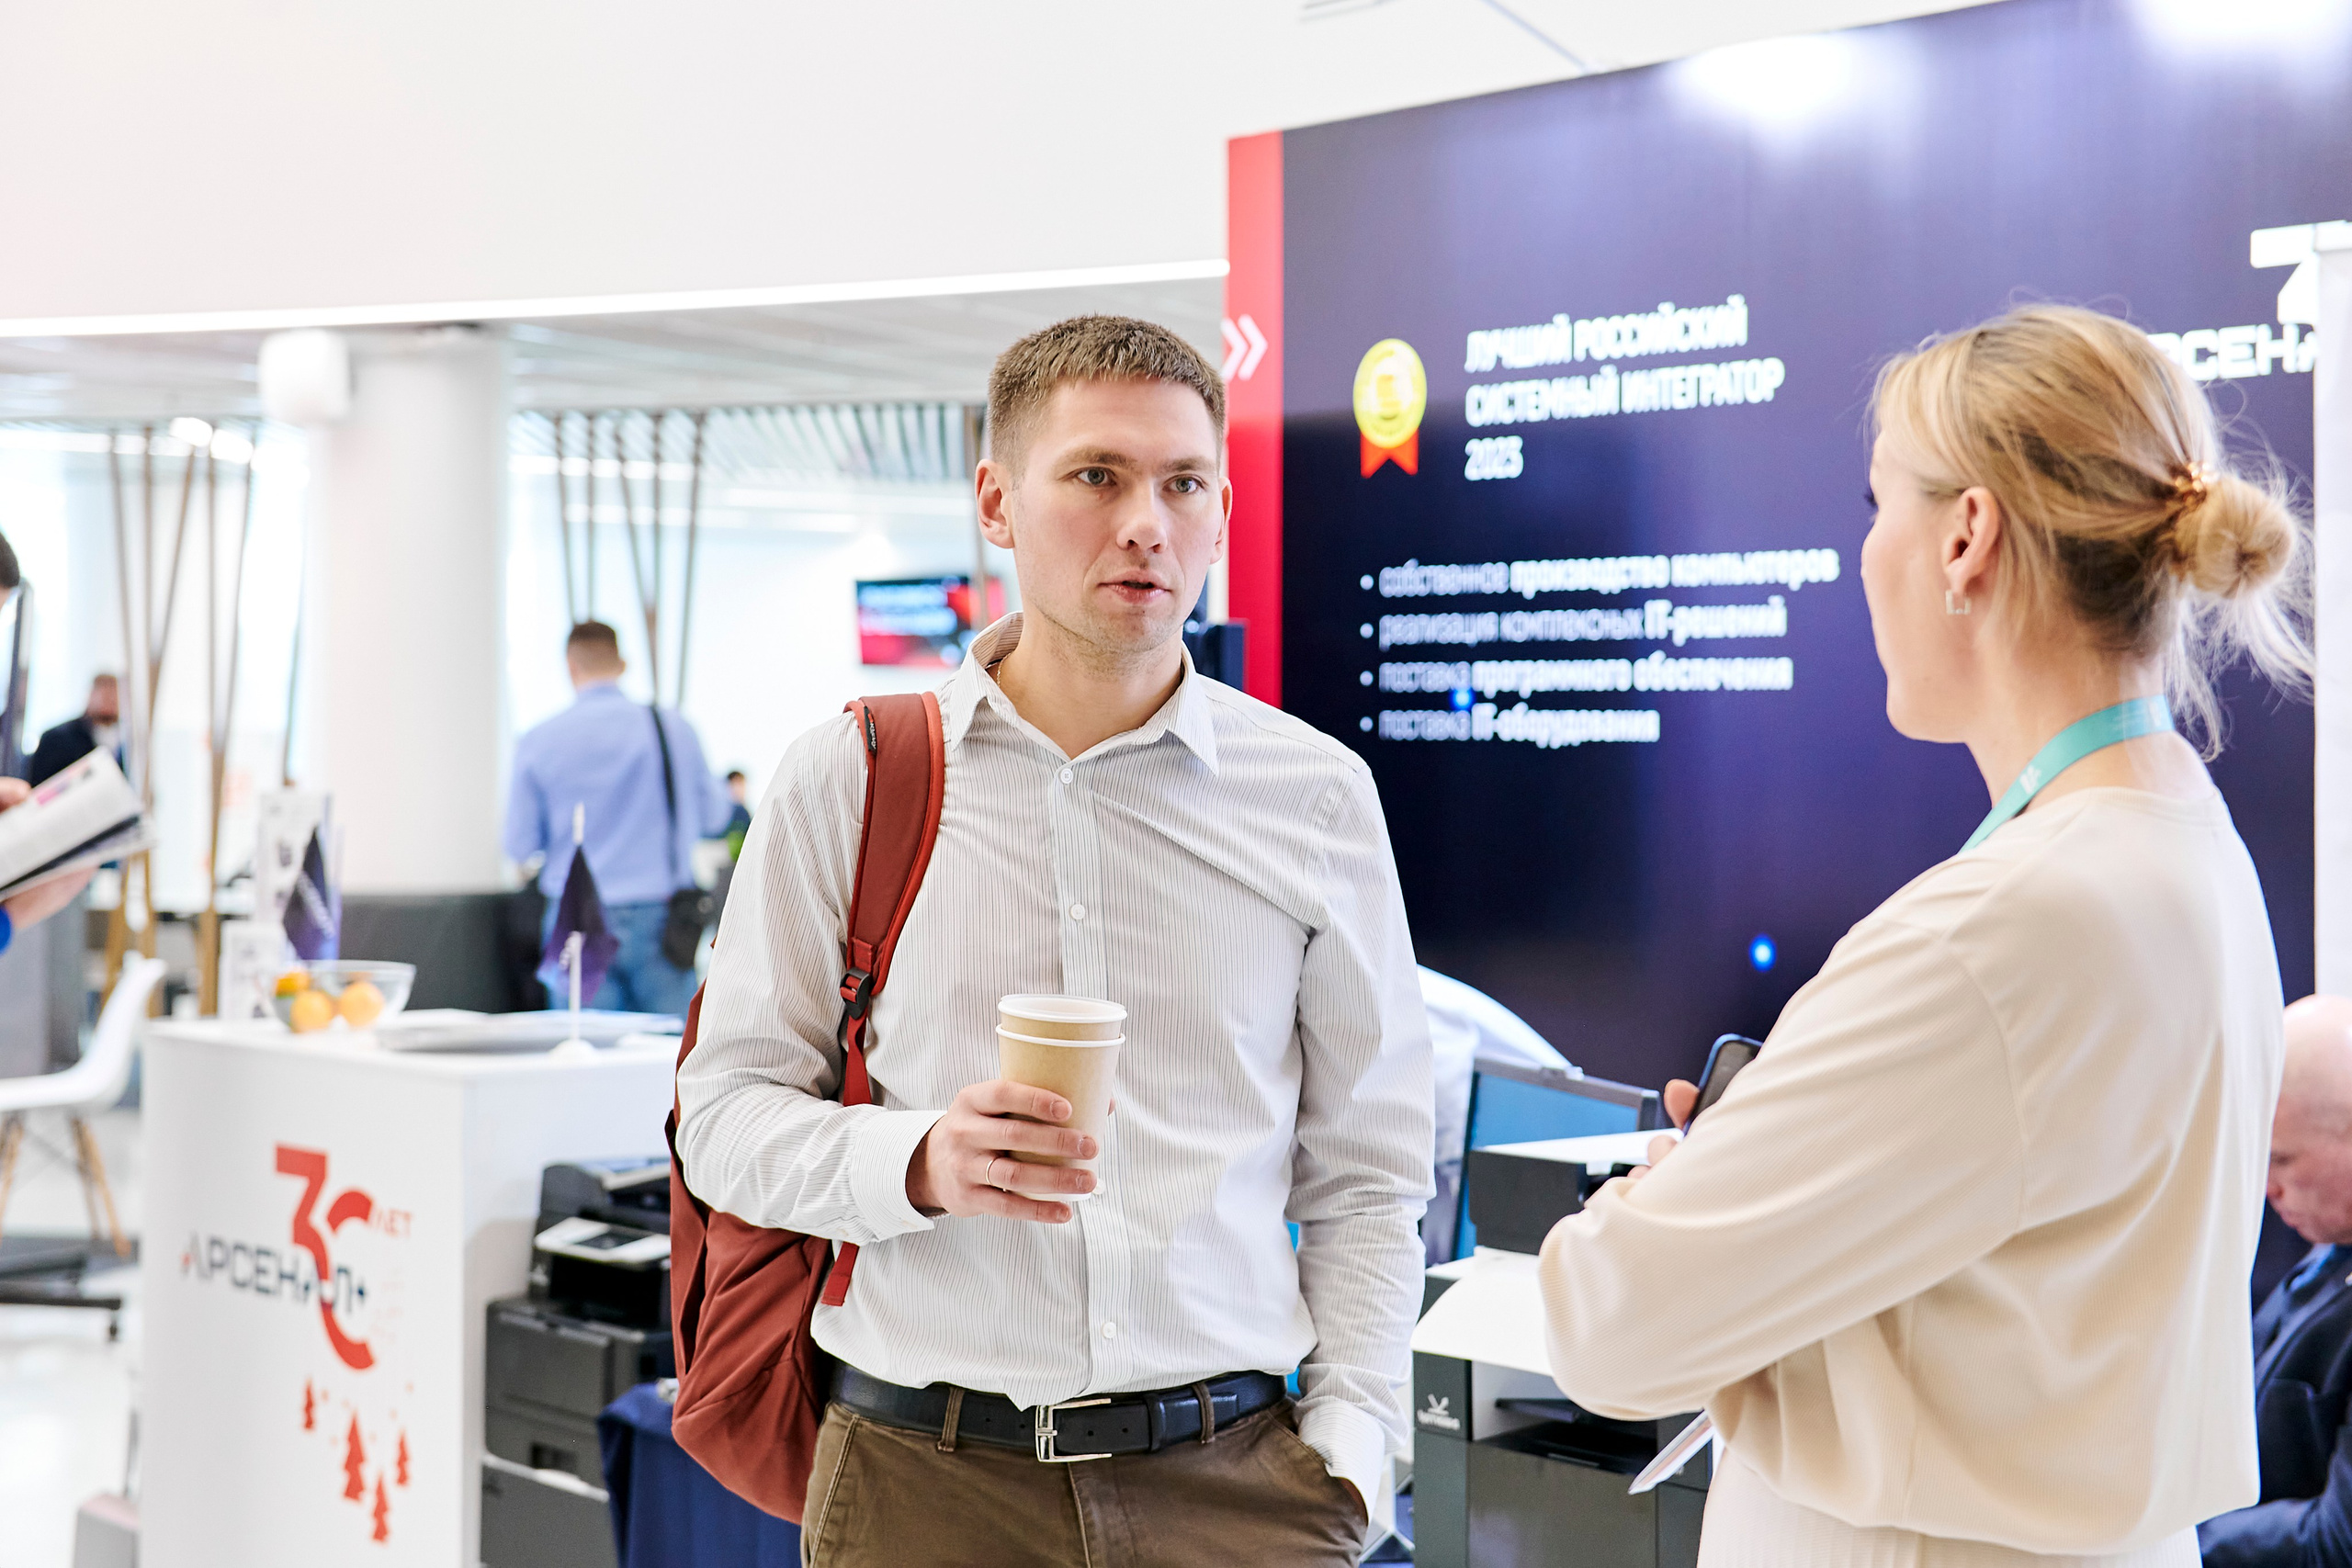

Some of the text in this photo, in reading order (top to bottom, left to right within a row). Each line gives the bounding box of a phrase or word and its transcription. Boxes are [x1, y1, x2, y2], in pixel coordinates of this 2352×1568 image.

[1464, 294, 1747, 373] ЛУЧШИЙ РОССИЙСКИЙ
[1465, 356, 1785, 427] СИСТЕМНЫЙ ИНТЕГРАТОР
[1510, 557, 1670, 600] производство
[1670, 548, 1840, 591] компьютеров
